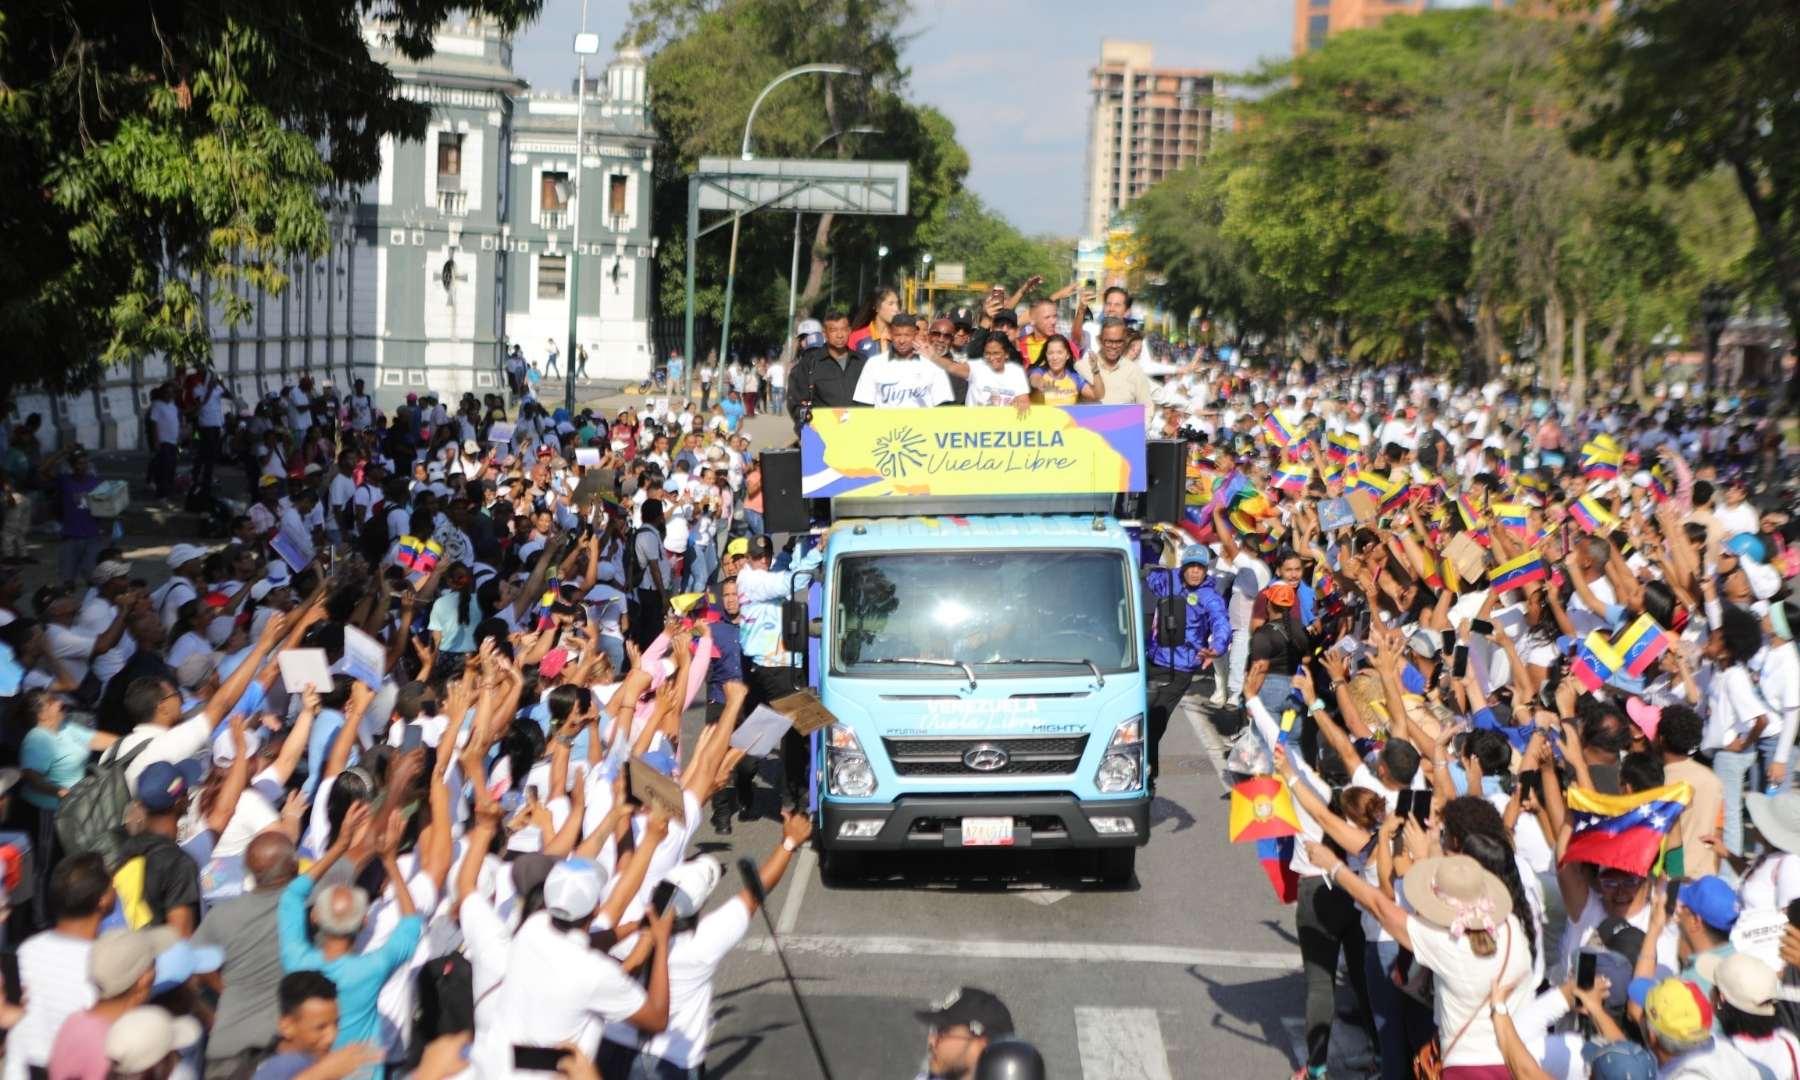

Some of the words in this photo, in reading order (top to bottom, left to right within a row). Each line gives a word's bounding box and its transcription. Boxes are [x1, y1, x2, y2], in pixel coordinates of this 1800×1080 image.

[934, 430, 1065, 449] VENEZUELA
[928, 451, 1004, 475] Vuela
[1004, 450, 1077, 474] Libre
[927, 699, 1038, 713] VENEZUELA
[1031, 723, 1087, 733] MIGHTY
